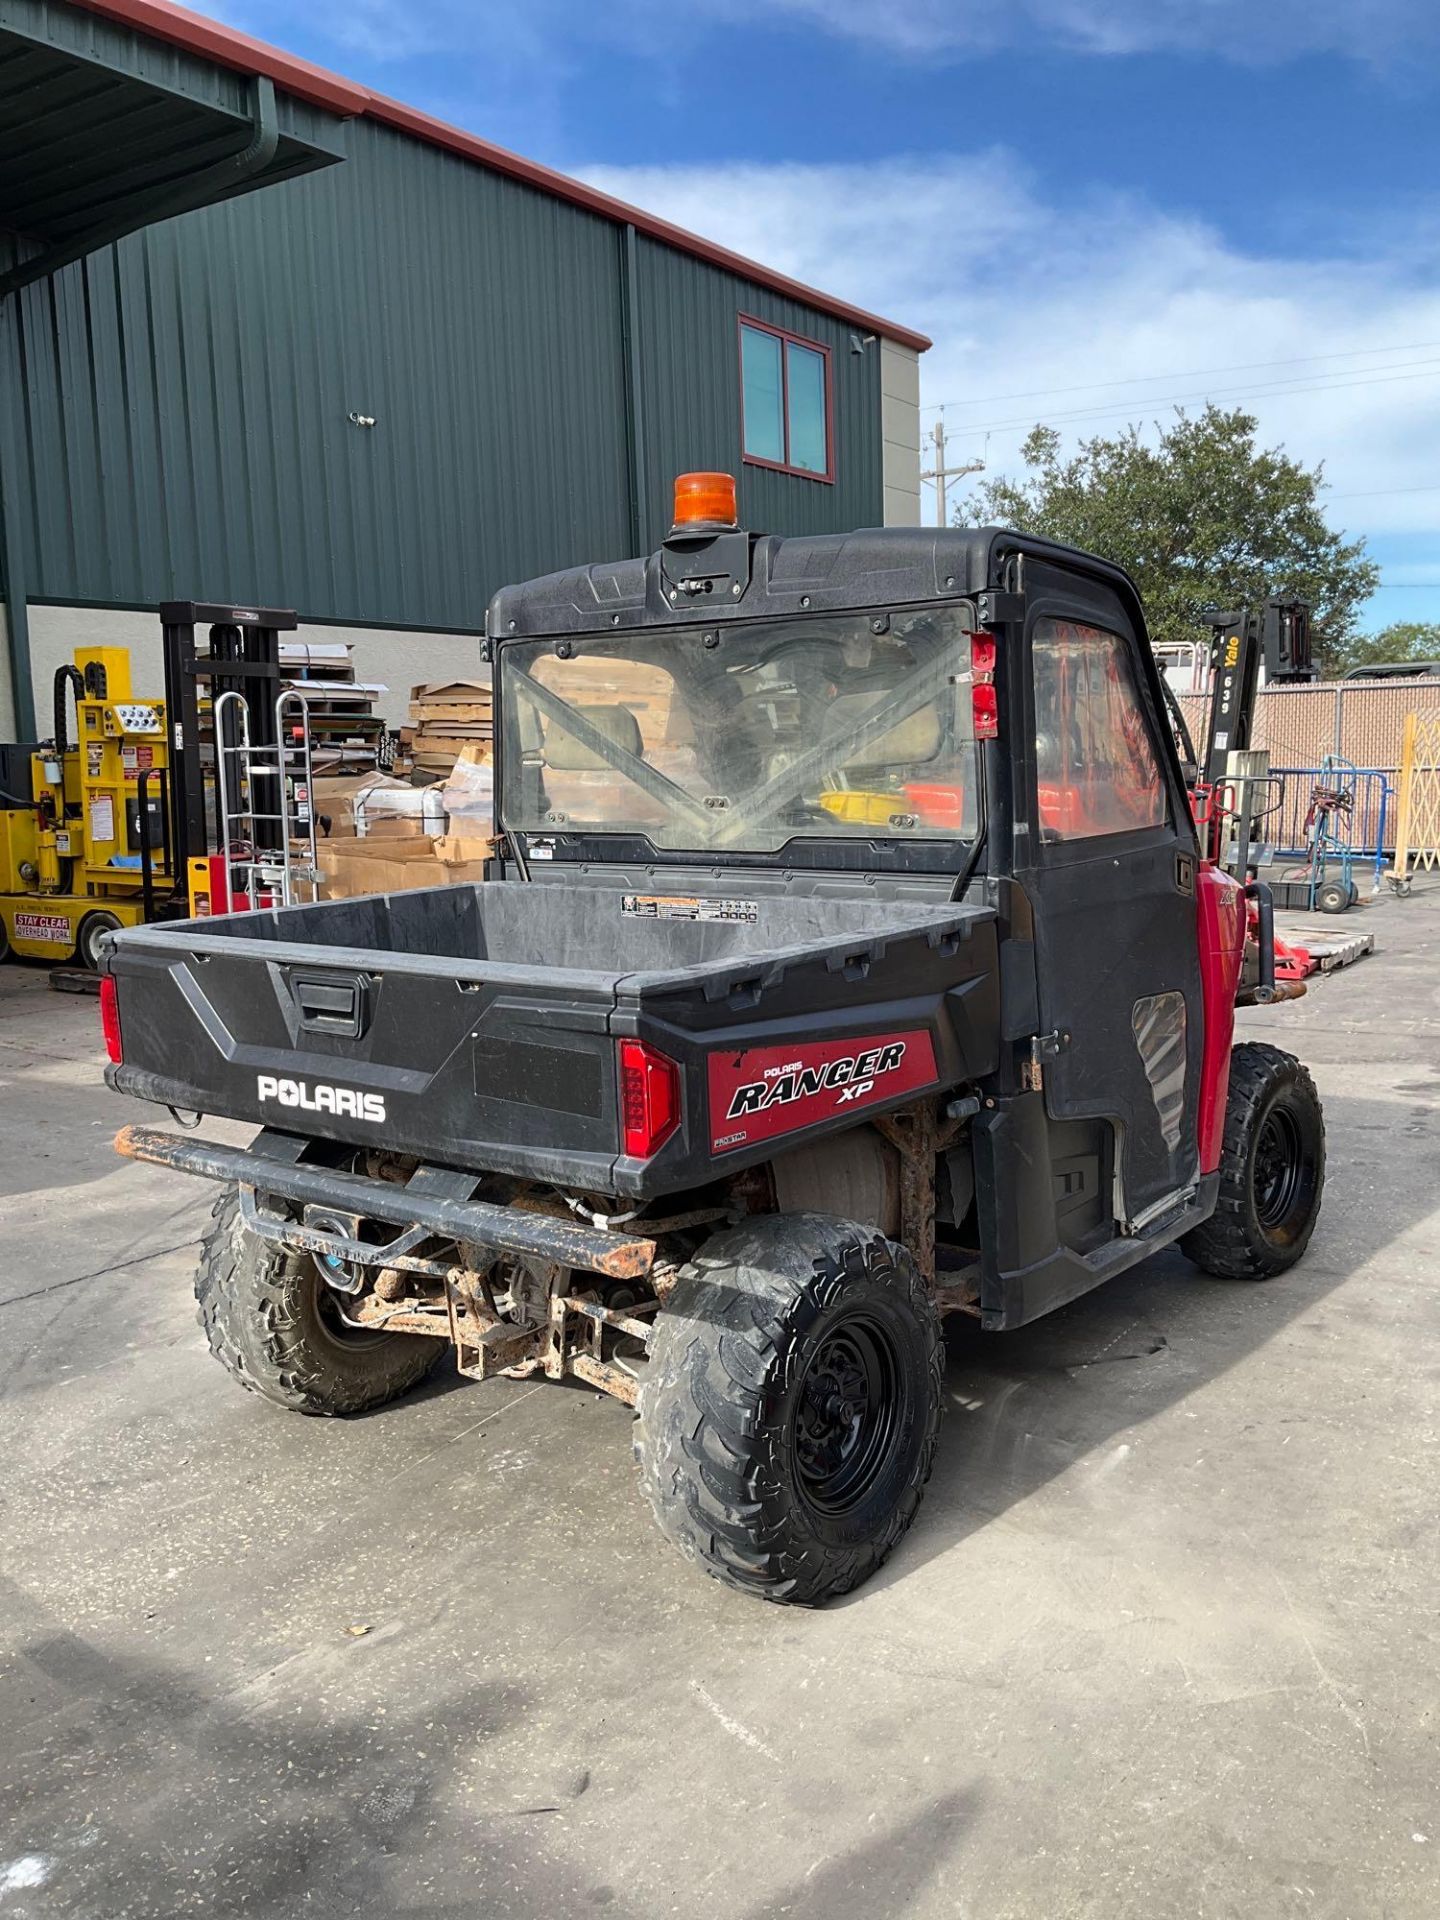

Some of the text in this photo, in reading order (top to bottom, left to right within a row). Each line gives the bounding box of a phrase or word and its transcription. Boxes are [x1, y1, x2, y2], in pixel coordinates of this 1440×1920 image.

[1221, 676, 1233, 714] 639
[16, 926, 49, 937] OVERHEAD
[17, 915, 68, 929] STAY CLEAR
[725, 1041, 906, 1119] RANGER
[763, 1061, 803, 1079] POLARIS
[257, 1075, 386, 1123] POLARIS
[836, 1080, 874, 1105] XP
